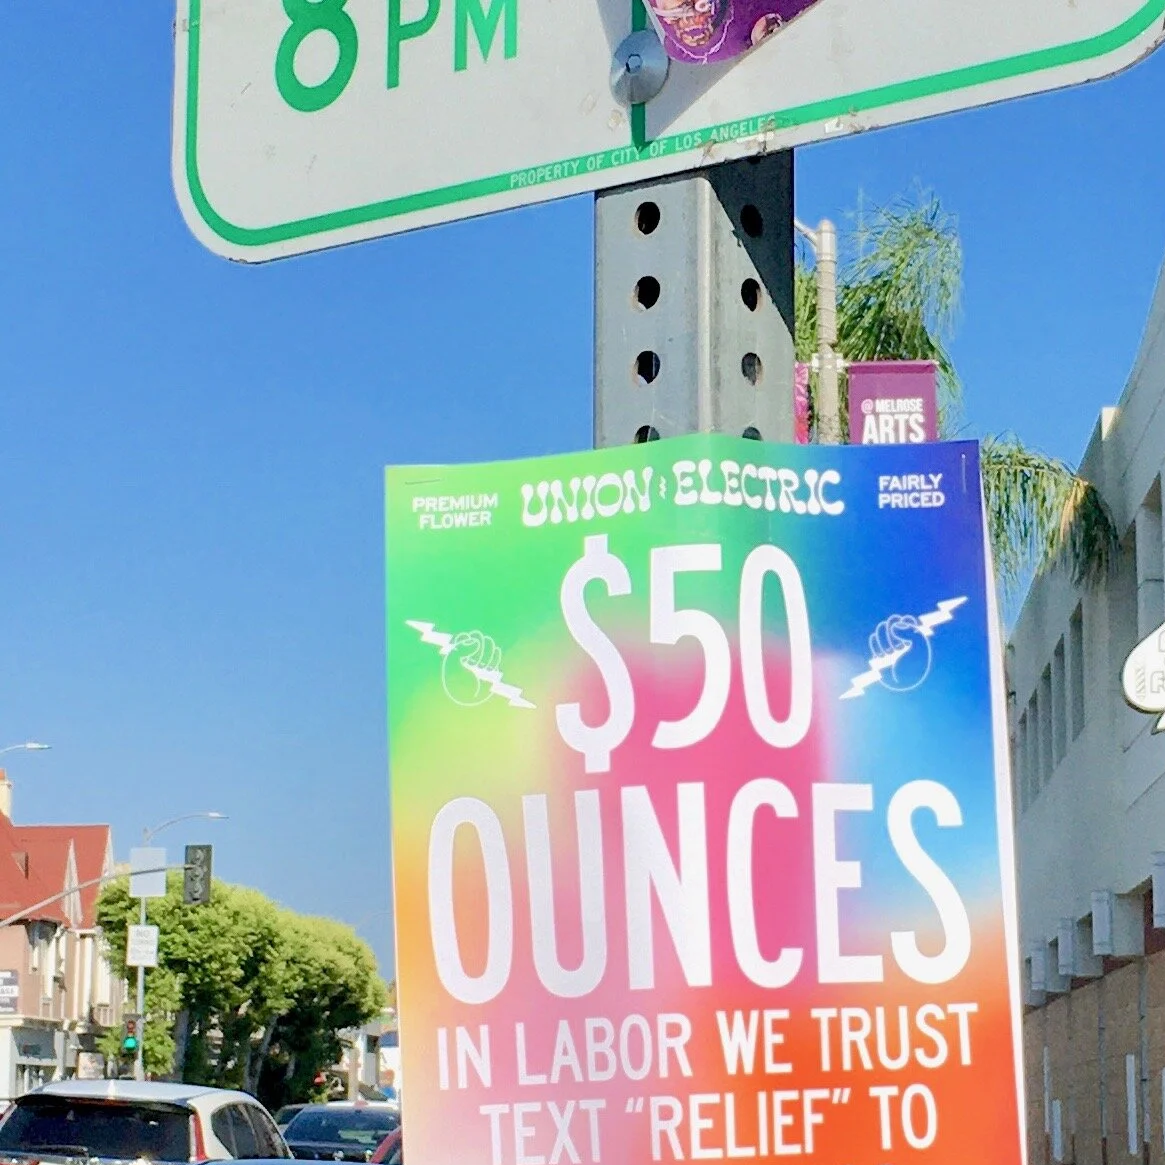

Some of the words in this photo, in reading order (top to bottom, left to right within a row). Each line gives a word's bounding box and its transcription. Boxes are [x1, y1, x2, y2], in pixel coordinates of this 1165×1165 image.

[275, 0, 358, 112] 8
[386, 0, 517, 89] PM
[511, 159, 580, 188] PROPERTY
[586, 153, 604, 171] OF
[610, 145, 642, 167] CITY
[651, 140, 668, 157] OF
[675, 132, 701, 151] LOS
[710, 115, 776, 143] ANGELES
[862, 413, 926, 444] ARTS
[876, 398, 923, 413] MELROSE
[412, 492, 498, 515] PREMIUM
[520, 466, 653, 526] UNION
[673, 459, 845, 516] ELECTRIC
[879, 473, 944, 493] FAIRLY
[879, 491, 945, 509] PRICED
[418, 510, 492, 529] FLOWER
[555, 533, 813, 774] $50
[428, 777, 972, 1005] OUNCES
[437, 1024, 492, 1091] IN
[515, 1013, 693, 1087] LABOR
[716, 1009, 793, 1076] WE
[811, 1002, 979, 1072] TRUST
[625, 1087, 851, 1161] "RELIEF"
[869, 1083, 938, 1151] TO
